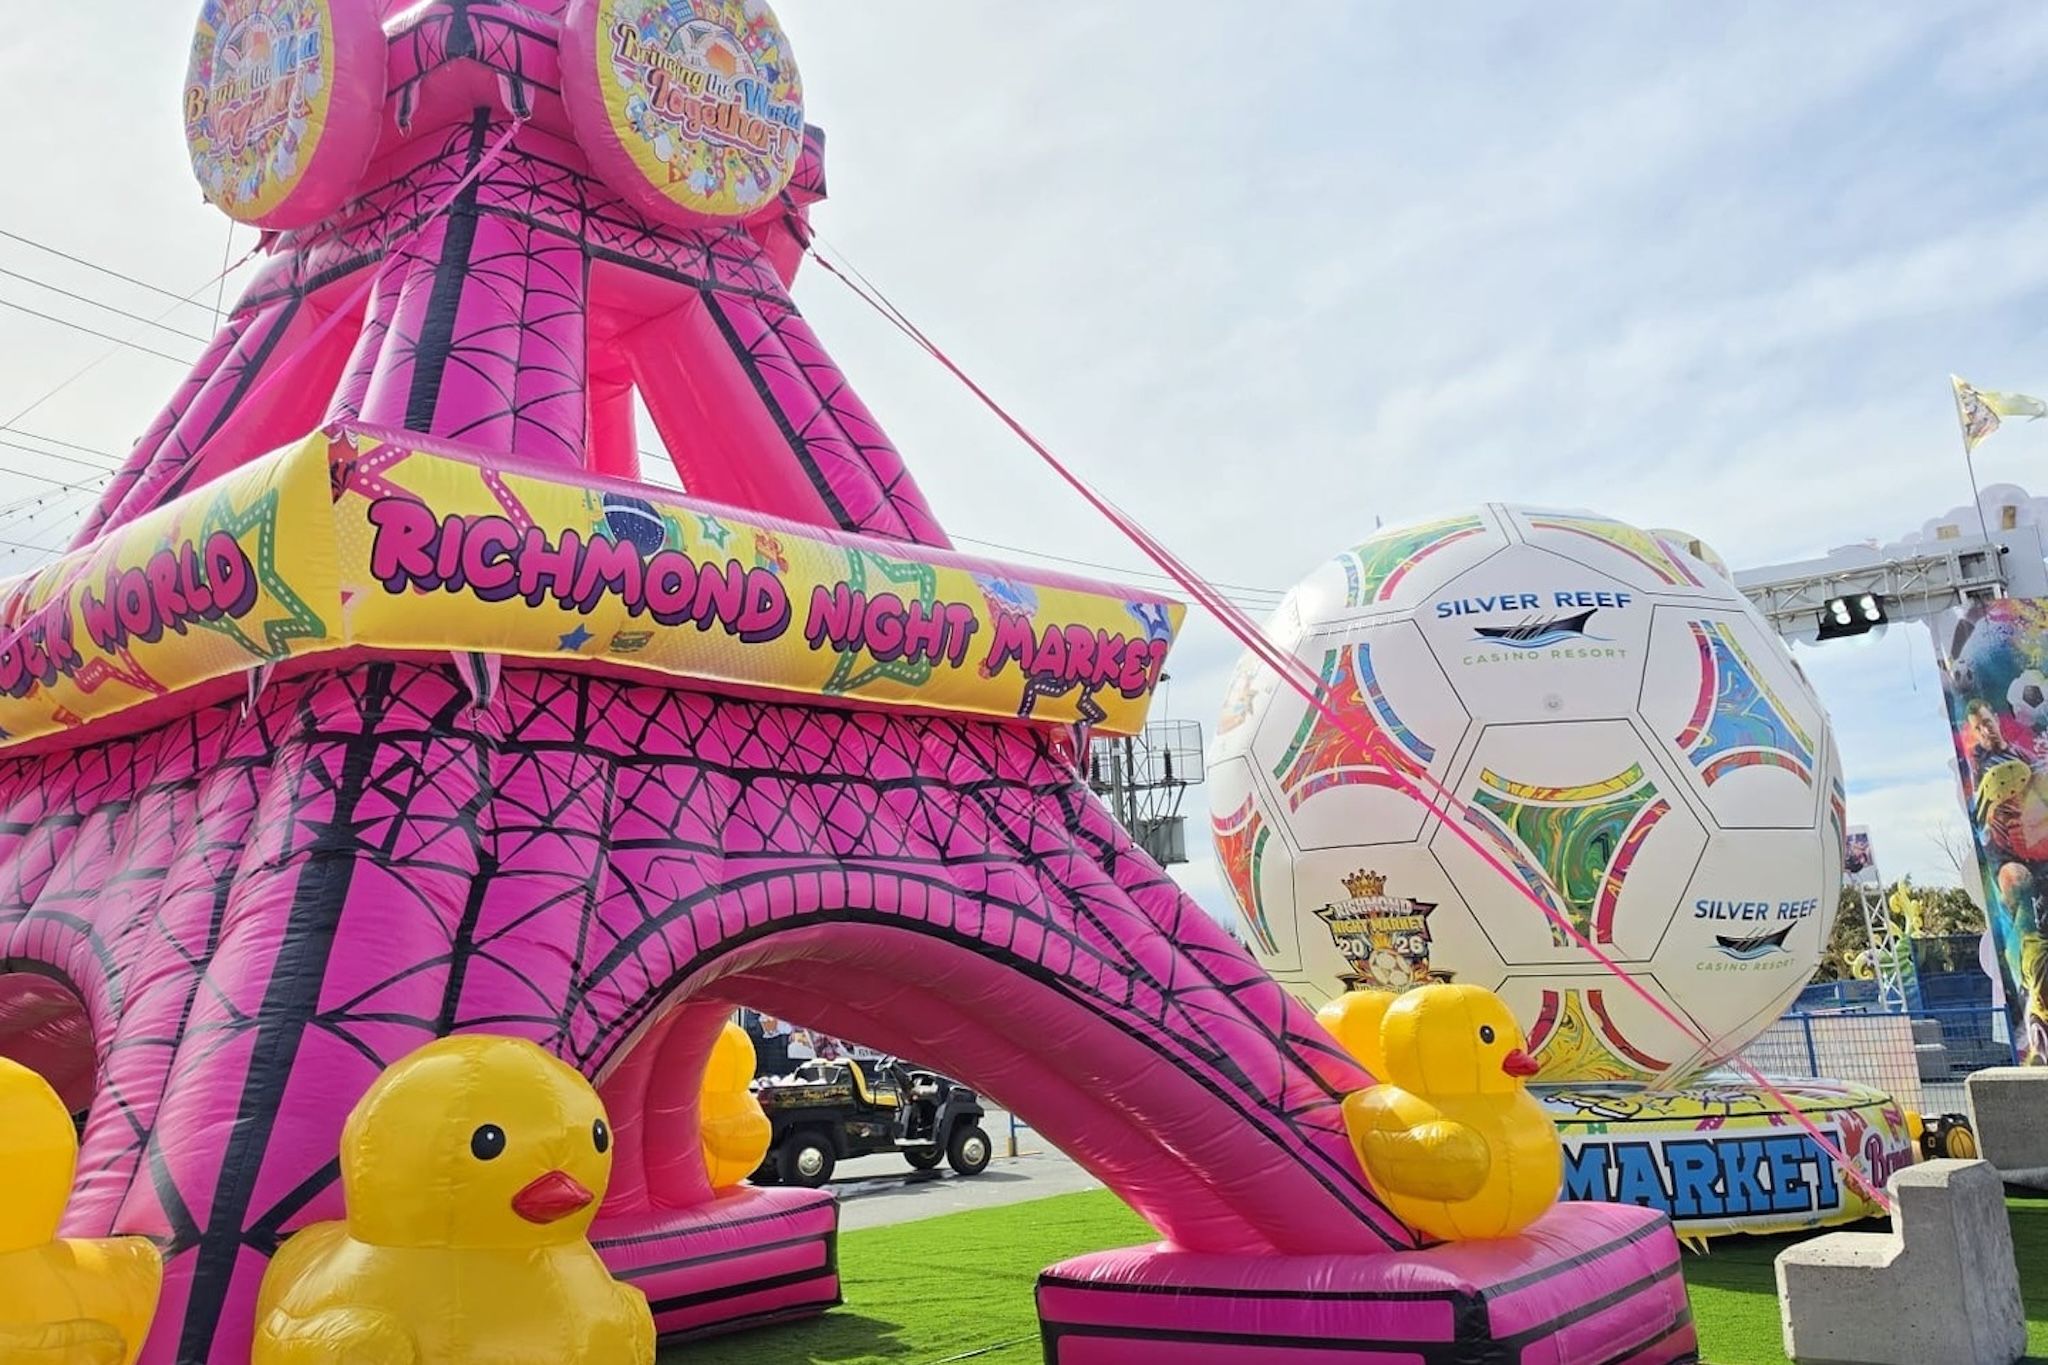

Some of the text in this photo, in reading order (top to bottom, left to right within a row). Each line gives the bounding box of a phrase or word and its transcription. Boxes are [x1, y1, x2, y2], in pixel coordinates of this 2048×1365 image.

[735, 77, 802, 130] World
[81, 529, 259, 656] WORLD
[367, 496, 1169, 700] RICHMOND NIGHT MARKET
[1436, 591, 1632, 618] SILVER REEF
[1462, 648, 1627, 666] CASINO RESORT
[1334, 897, 1414, 919] RICHMOND
[1694, 898, 1818, 921] SILVER REEF
[1340, 936, 1425, 958] 20 26
[1696, 958, 1796, 972] CASINO RESORT
[1557, 1132, 1841, 1219] MARKET
